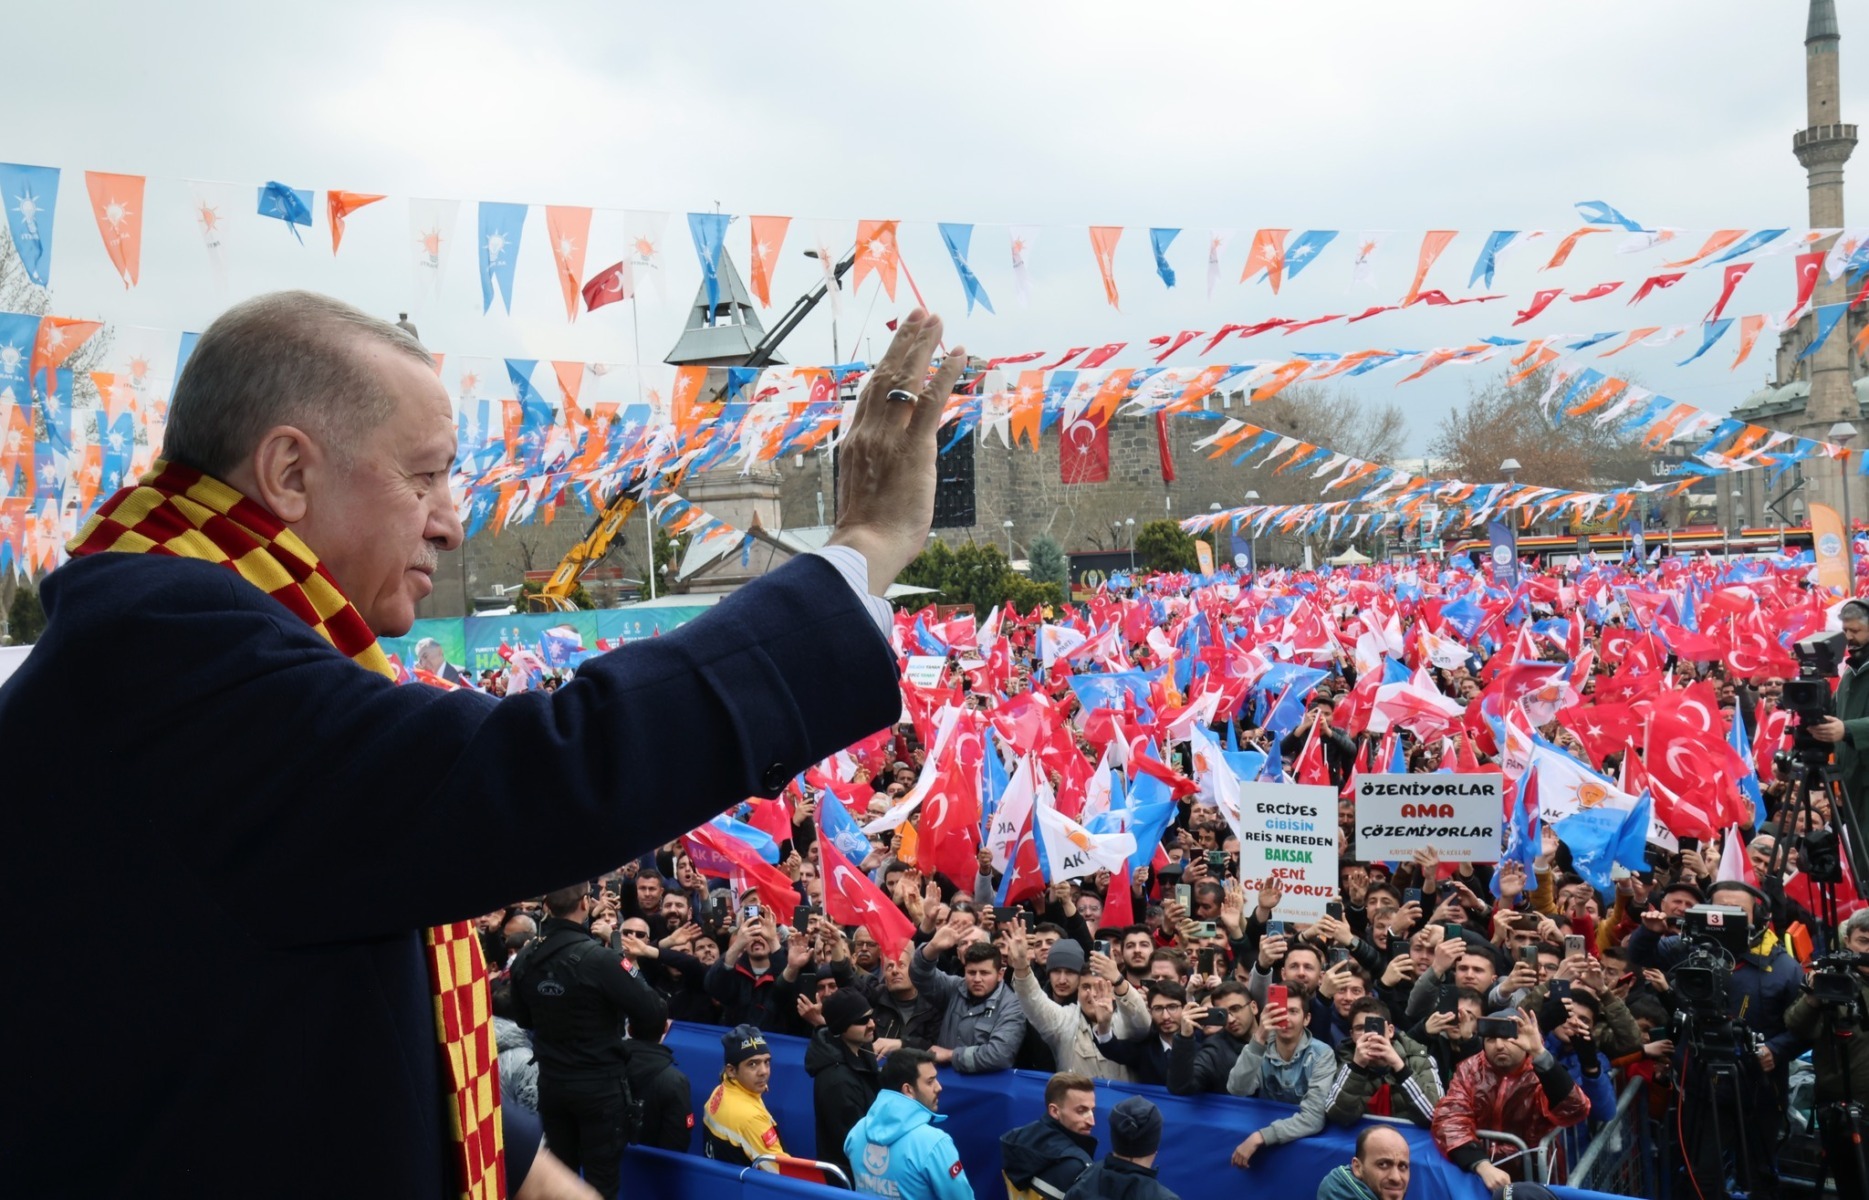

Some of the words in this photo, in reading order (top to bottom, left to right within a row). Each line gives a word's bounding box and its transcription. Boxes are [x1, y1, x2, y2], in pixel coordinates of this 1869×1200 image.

[1361, 782, 1495, 796] ÖZENİYORLAR
[1256, 802, 1318, 817] ERCİYES
[1401, 803, 1454, 818] AMA
[1265, 817, 1314, 832] GİBİSİN
[1361, 824, 1493, 839] ÇÖZEMİYORLAR
[1246, 830, 1272, 842] REİS
[1276, 834, 1333, 847] NEREDEN
[1265, 848, 1313, 864] BAKSAK
[1271, 867, 1306, 881] SENİ
[1711, 914, 1720, 924] 3
